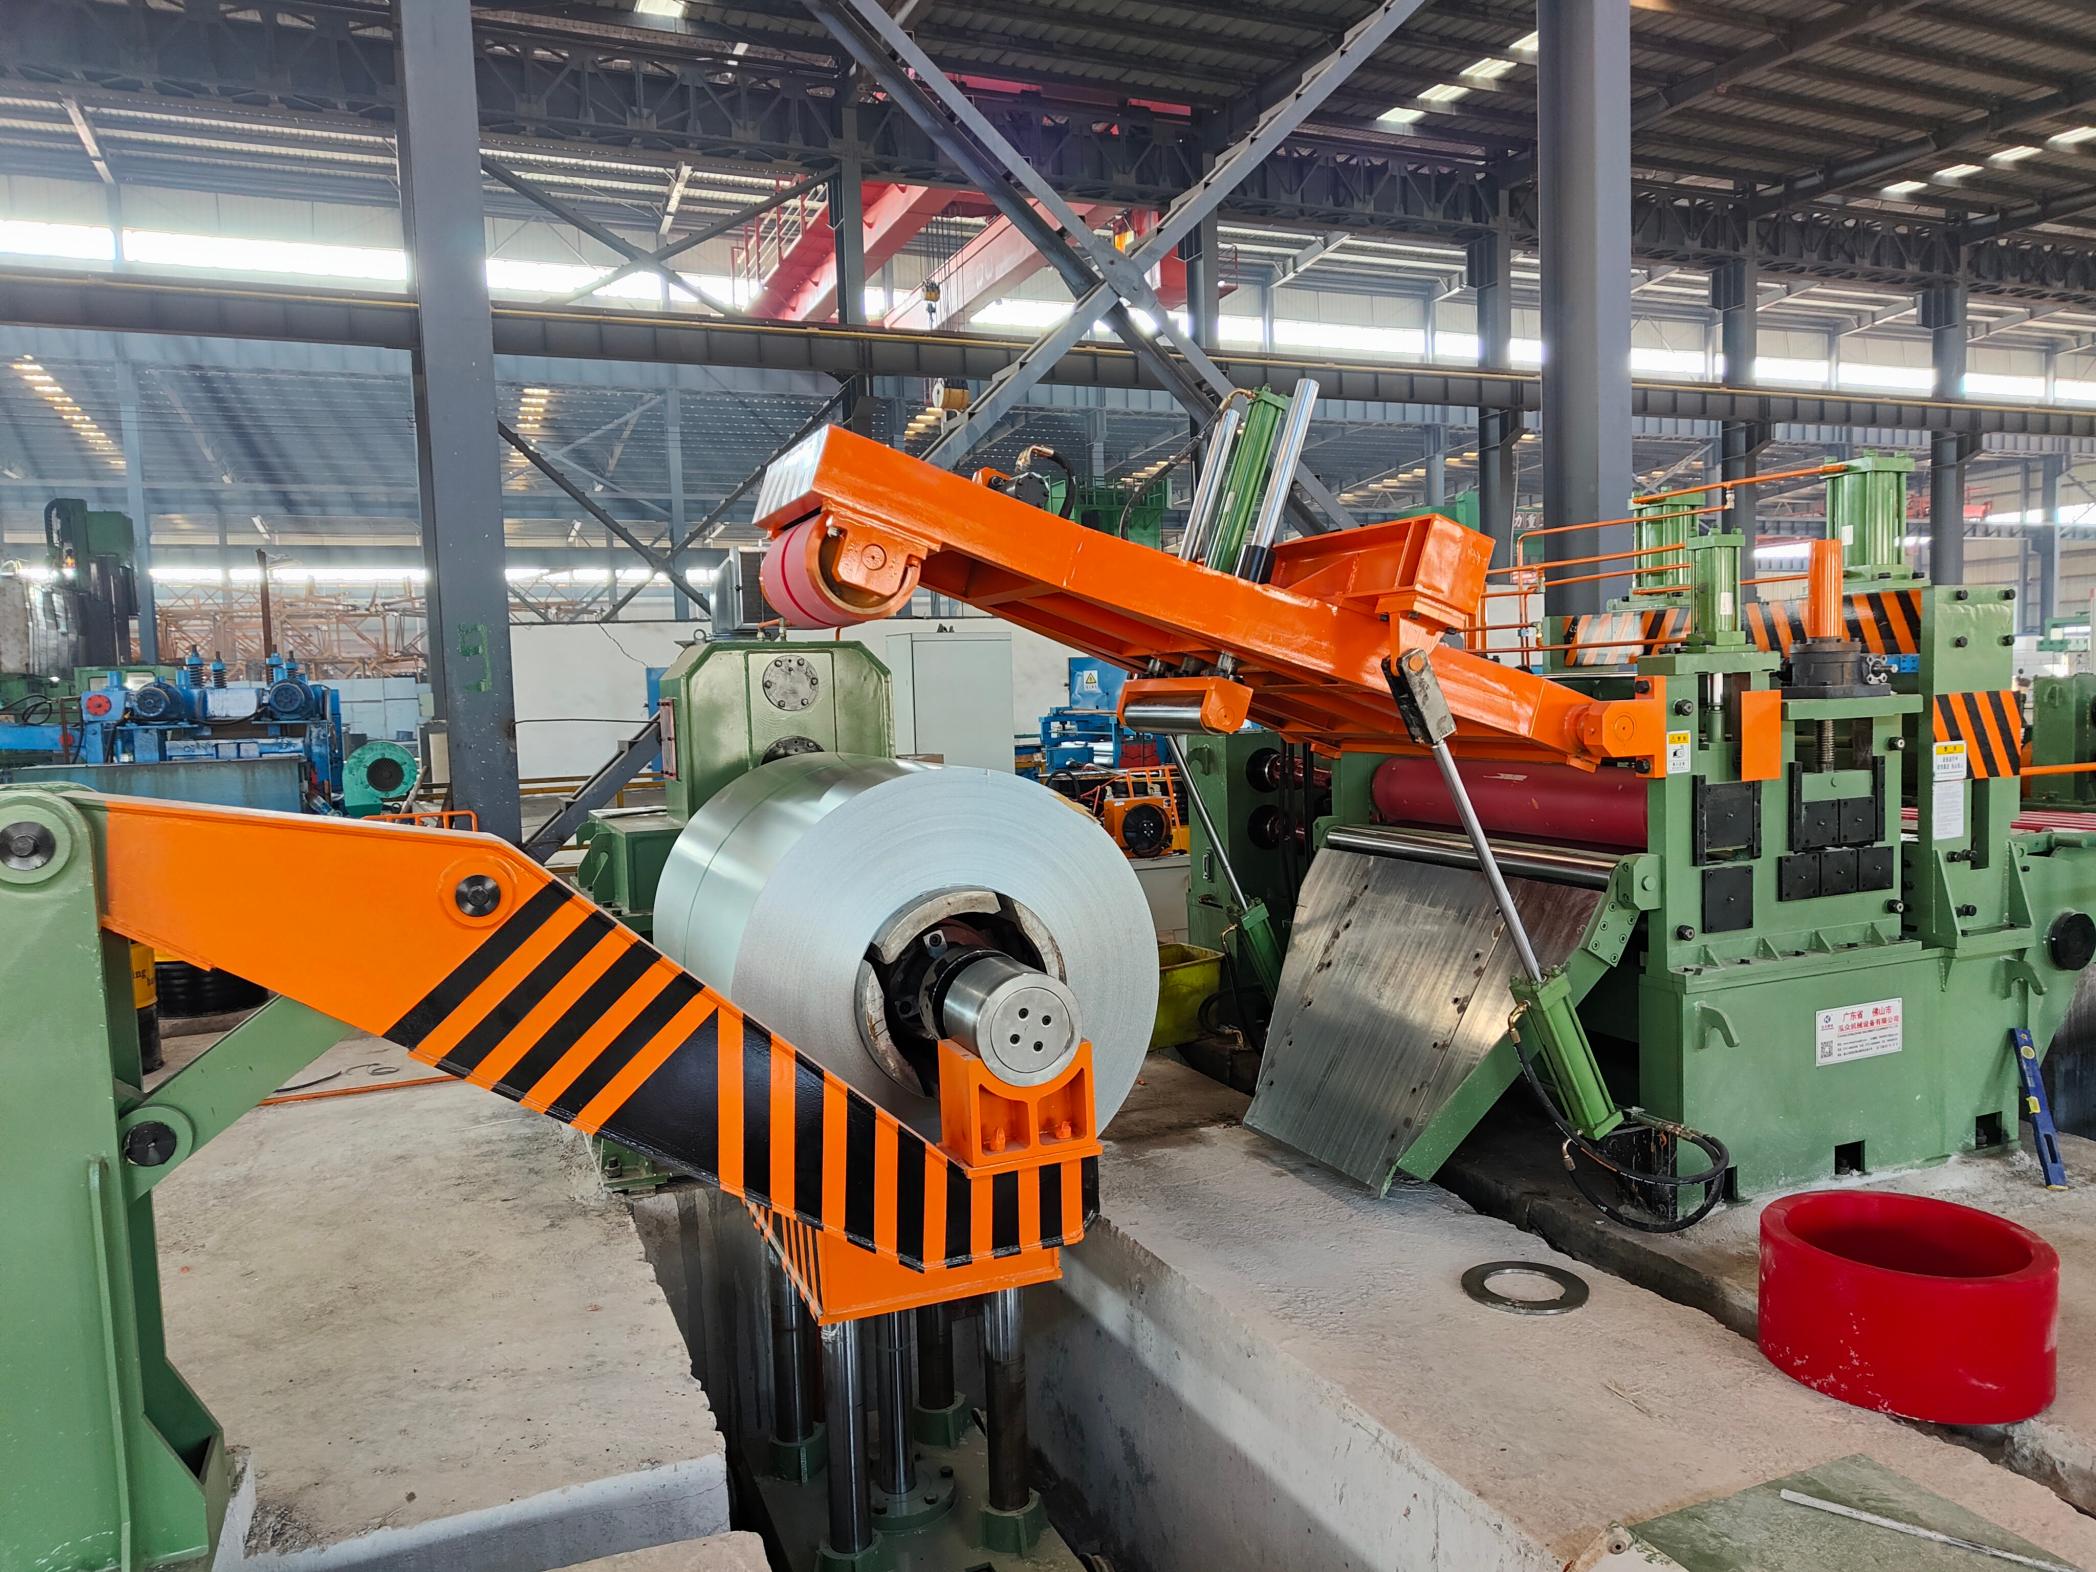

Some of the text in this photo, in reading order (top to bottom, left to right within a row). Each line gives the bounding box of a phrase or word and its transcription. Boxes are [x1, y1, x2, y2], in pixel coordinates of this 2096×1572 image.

[1843, 1006, 1892, 1022] 广东省 佛山市
